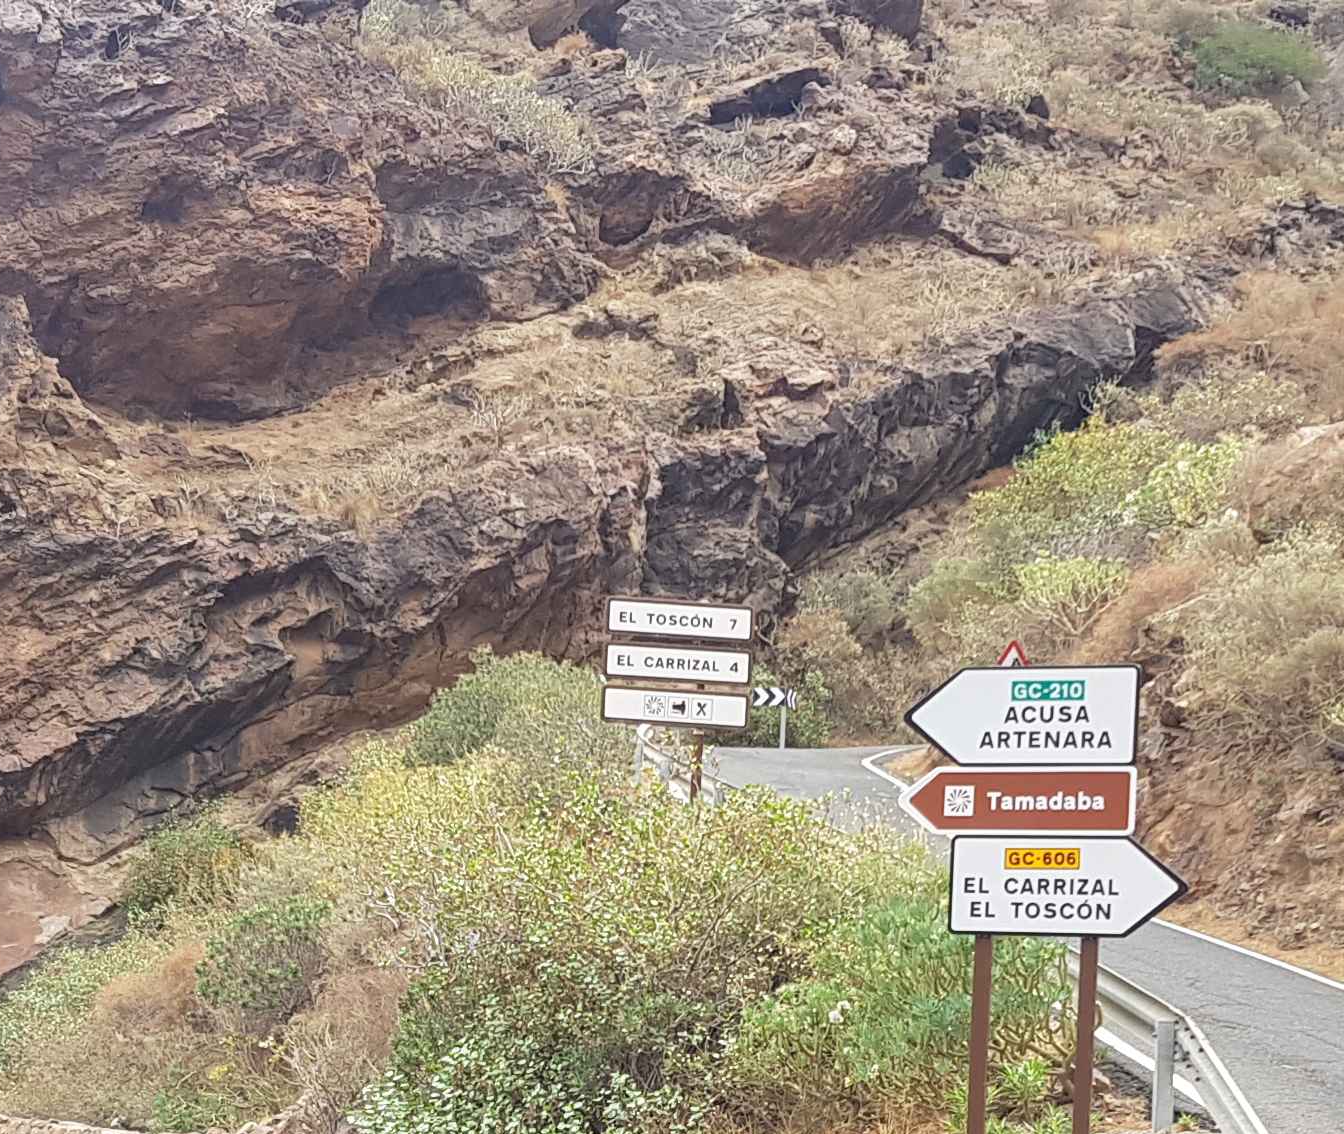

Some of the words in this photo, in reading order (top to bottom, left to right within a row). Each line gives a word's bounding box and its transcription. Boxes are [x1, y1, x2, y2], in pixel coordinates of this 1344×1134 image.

[619, 611, 637, 624] EL
[646, 612, 713, 629] TOSCÓN
[729, 619, 737, 630] 7
[617, 654, 634, 667] EL
[644, 656, 720, 672] CARRIZAL
[729, 662, 739, 673] 4
[1013, 683, 1083, 699] GC-210
[1004, 705, 1090, 724] ACUSA
[979, 731, 1112, 749] ARTENARA
[986, 791, 1105, 811] Tamadaba
[1008, 851, 1076, 866] GC-606
[963, 877, 989, 894] EL
[1004, 877, 1120, 896] CARRIZAL
[969, 901, 995, 918] EL
[1011, 899, 1112, 920] TOSCÓN
